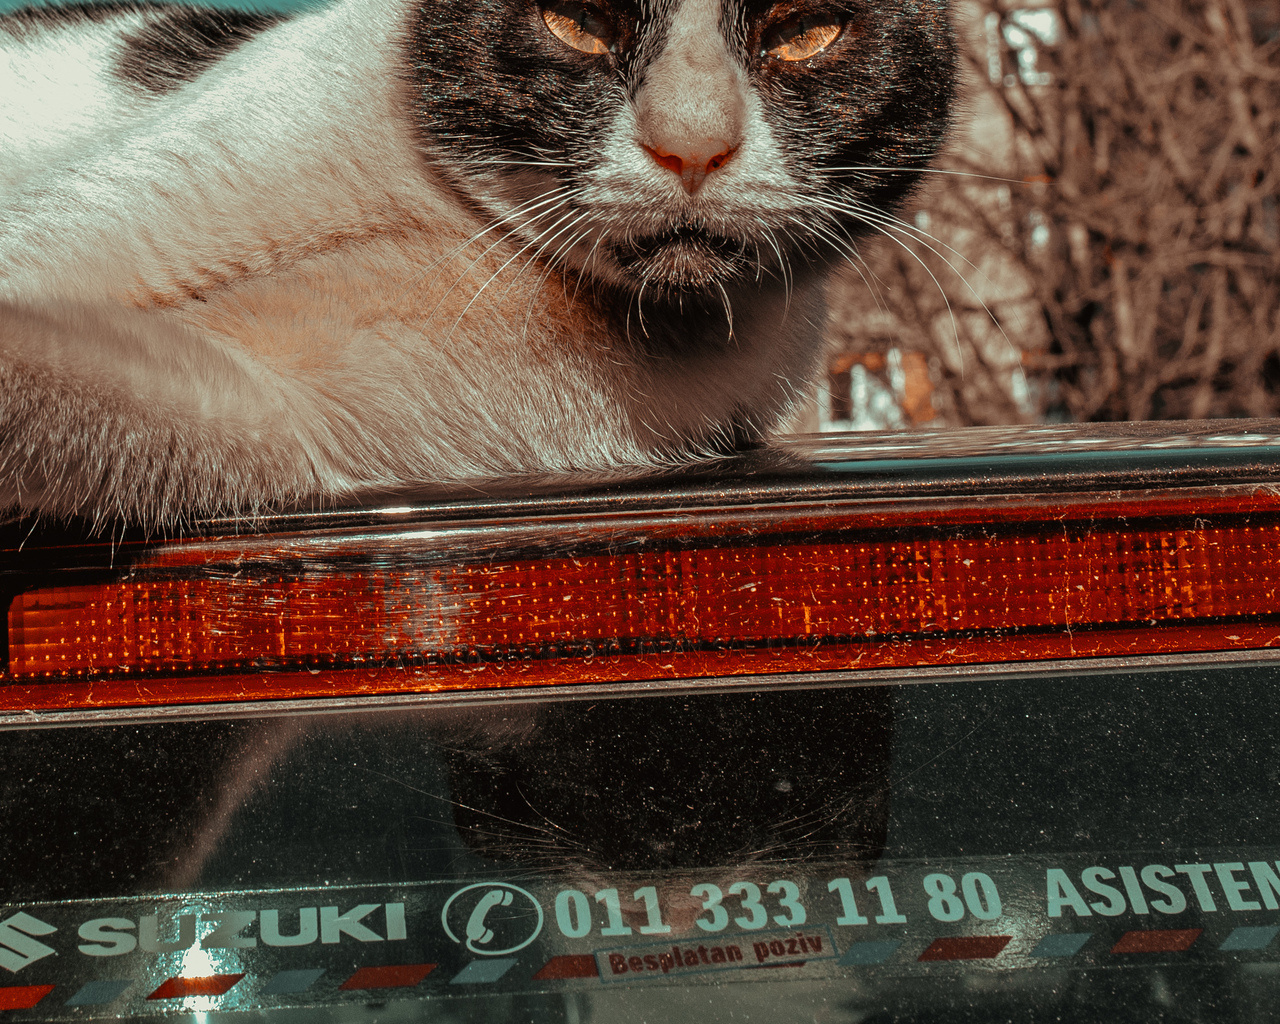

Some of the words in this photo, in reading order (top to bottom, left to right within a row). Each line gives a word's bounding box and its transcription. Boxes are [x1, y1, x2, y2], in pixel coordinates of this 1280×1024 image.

[714, 636, 755, 658] SAE
[78, 902, 407, 957] SUZUKI
[555, 886, 671, 938] 011
[690, 880, 807, 932] 333
[827, 876, 907, 926] 11
[923, 872, 1002, 922] 80
[1046, 861, 1280, 918] ASISTEN
[609, 945, 743, 974] Besplatan
[753, 932, 822, 962] poziv
